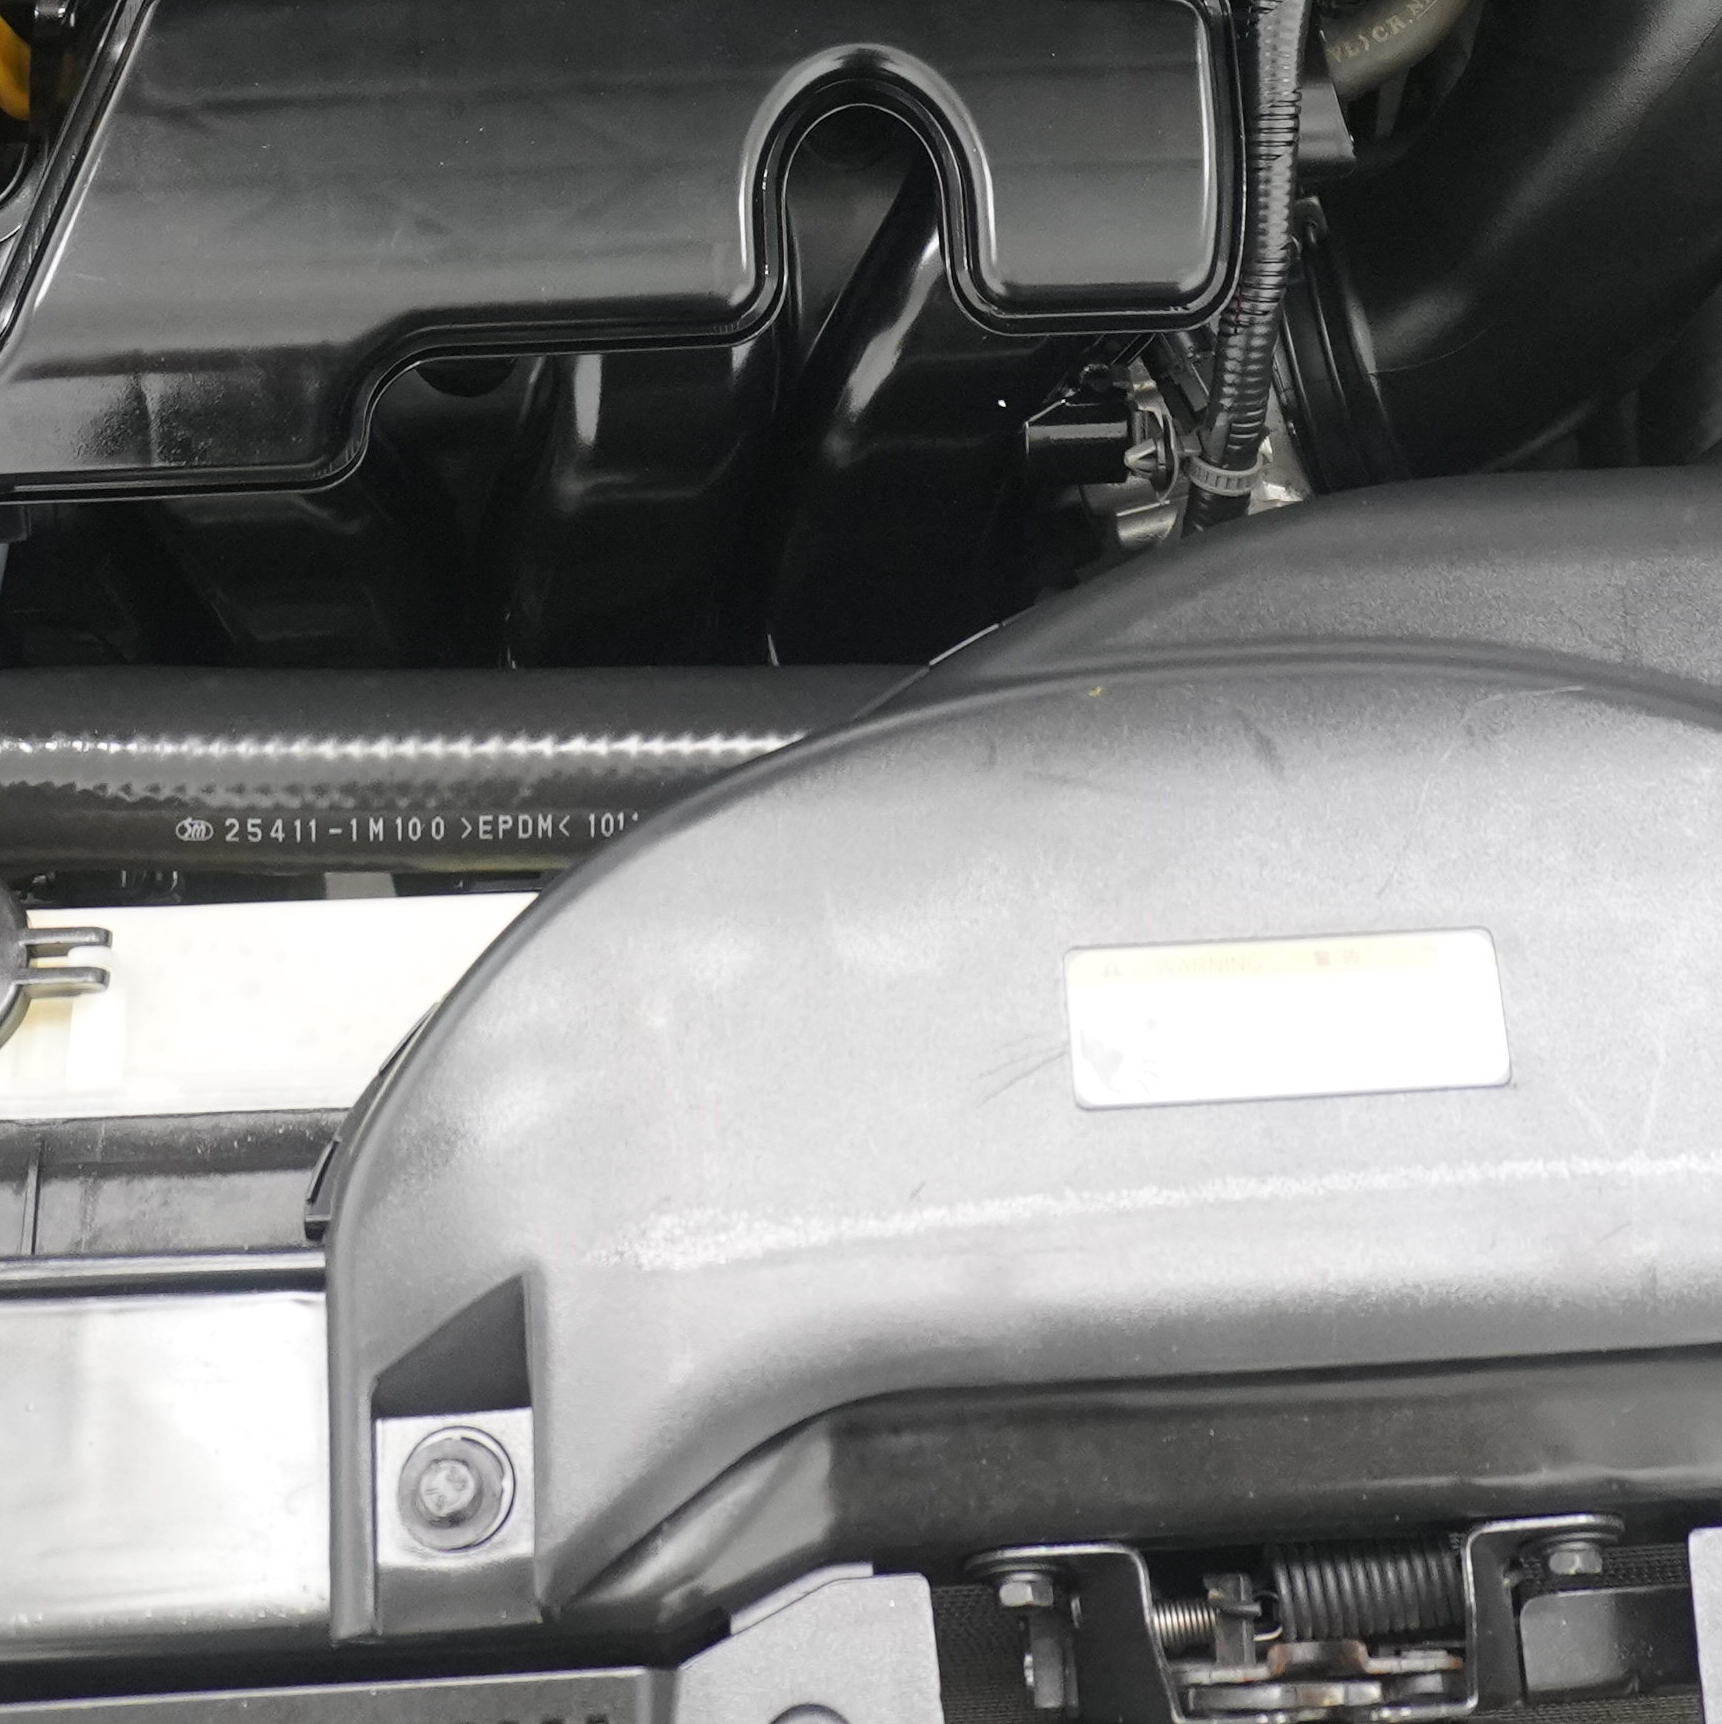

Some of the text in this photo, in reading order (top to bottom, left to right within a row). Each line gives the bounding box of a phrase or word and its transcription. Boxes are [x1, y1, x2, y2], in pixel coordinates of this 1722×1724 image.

[223, 816, 446, 844] 25411-1M100
[460, 813, 571, 840] >EPDM<
[586, 812, 641, 838] 101
